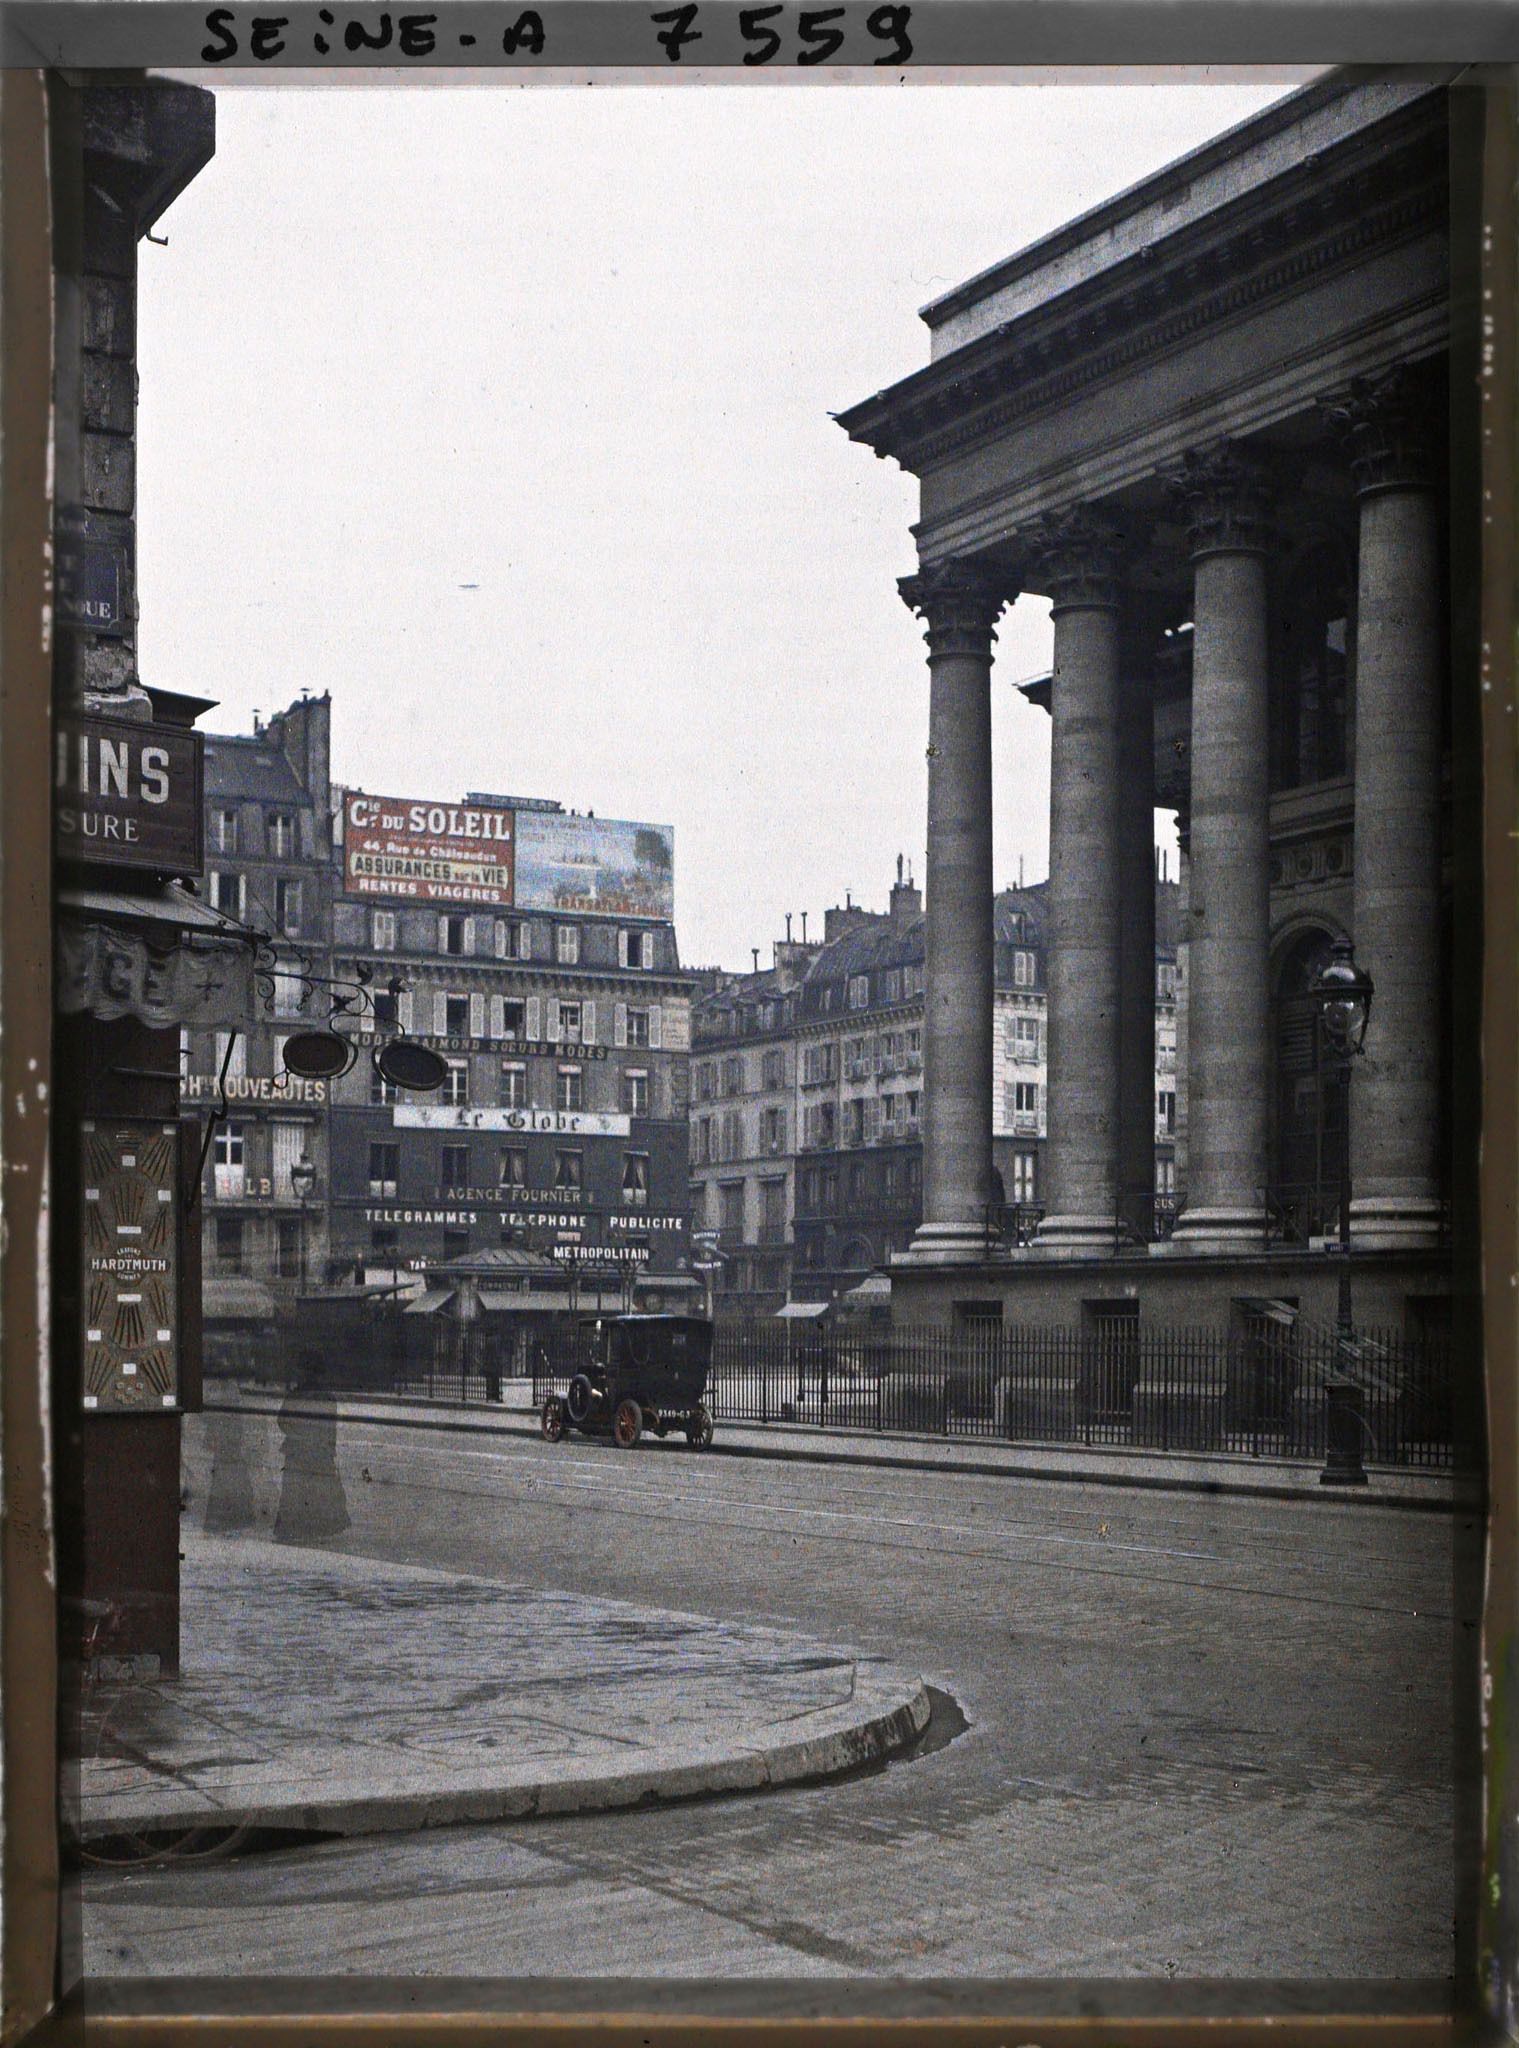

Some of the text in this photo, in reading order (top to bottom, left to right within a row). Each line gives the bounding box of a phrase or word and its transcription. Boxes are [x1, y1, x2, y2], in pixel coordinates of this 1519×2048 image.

[382, 815, 404, 831] DU
[409, 806, 510, 841] SOLEIL
[386, 841, 409, 855] Rue
[413, 845, 426, 856] de
[355, 856, 451, 879] ASSURANCES
[481, 867, 505, 884] VIE
[359, 879, 417, 895] RENTES
[554, 1044, 605, 1059] MODES
[502, 1109, 580, 1130] Globe
[447, 1188, 580, 1203] AGENCE FOURNIER
[365, 1209, 477, 1224] TELEGRAMMES
[610, 1216, 683, 1230] PUBLICITE
[554, 1246, 649, 1260] METROPOLITAIN
[92, 1258, 166, 1271] HARDTMUTH
